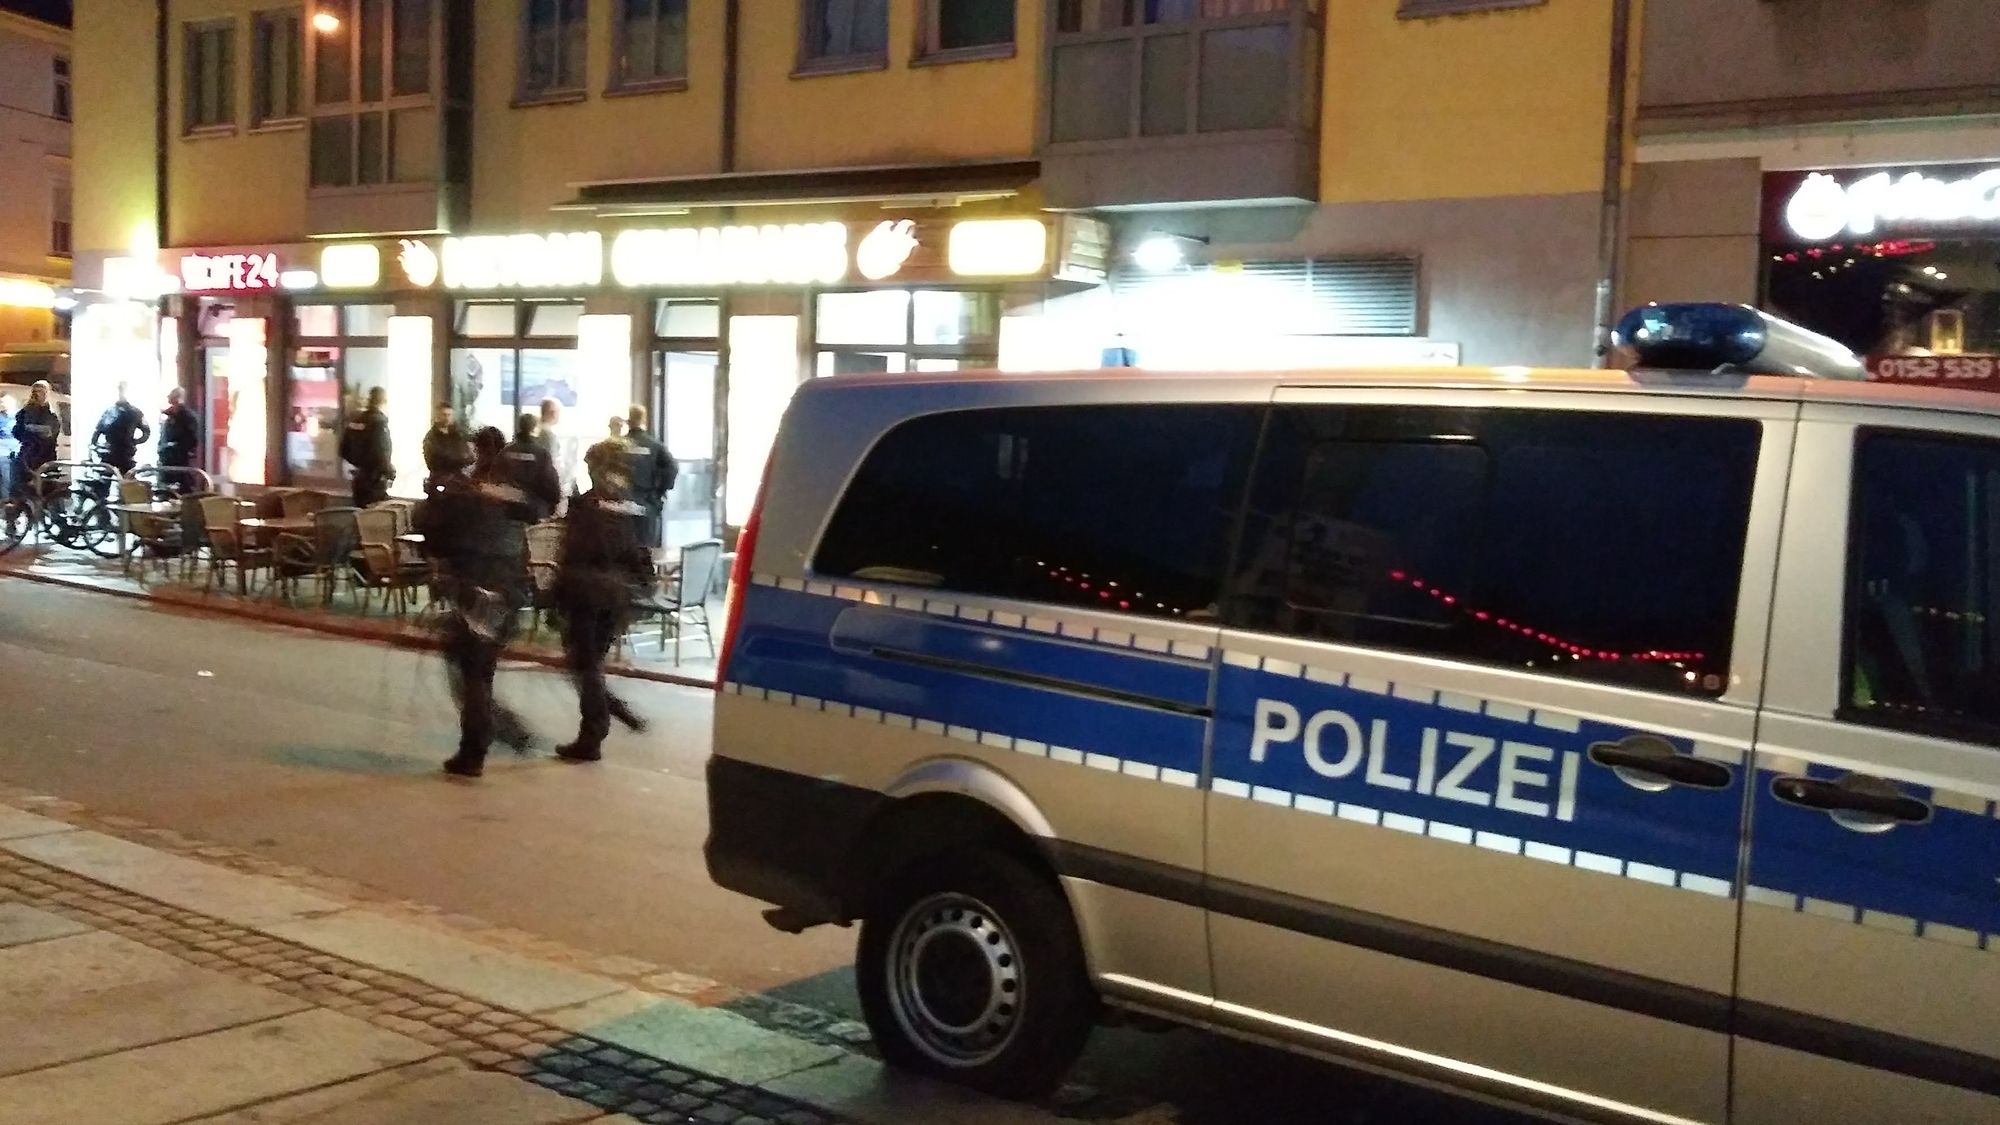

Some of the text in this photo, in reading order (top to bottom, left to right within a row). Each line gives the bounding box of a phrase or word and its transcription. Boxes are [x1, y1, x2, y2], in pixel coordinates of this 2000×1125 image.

[1878, 359, 1938, 378] 0152
[1943, 358, 1993, 378] 539
[1250, 698, 1581, 822] POLIZEI
